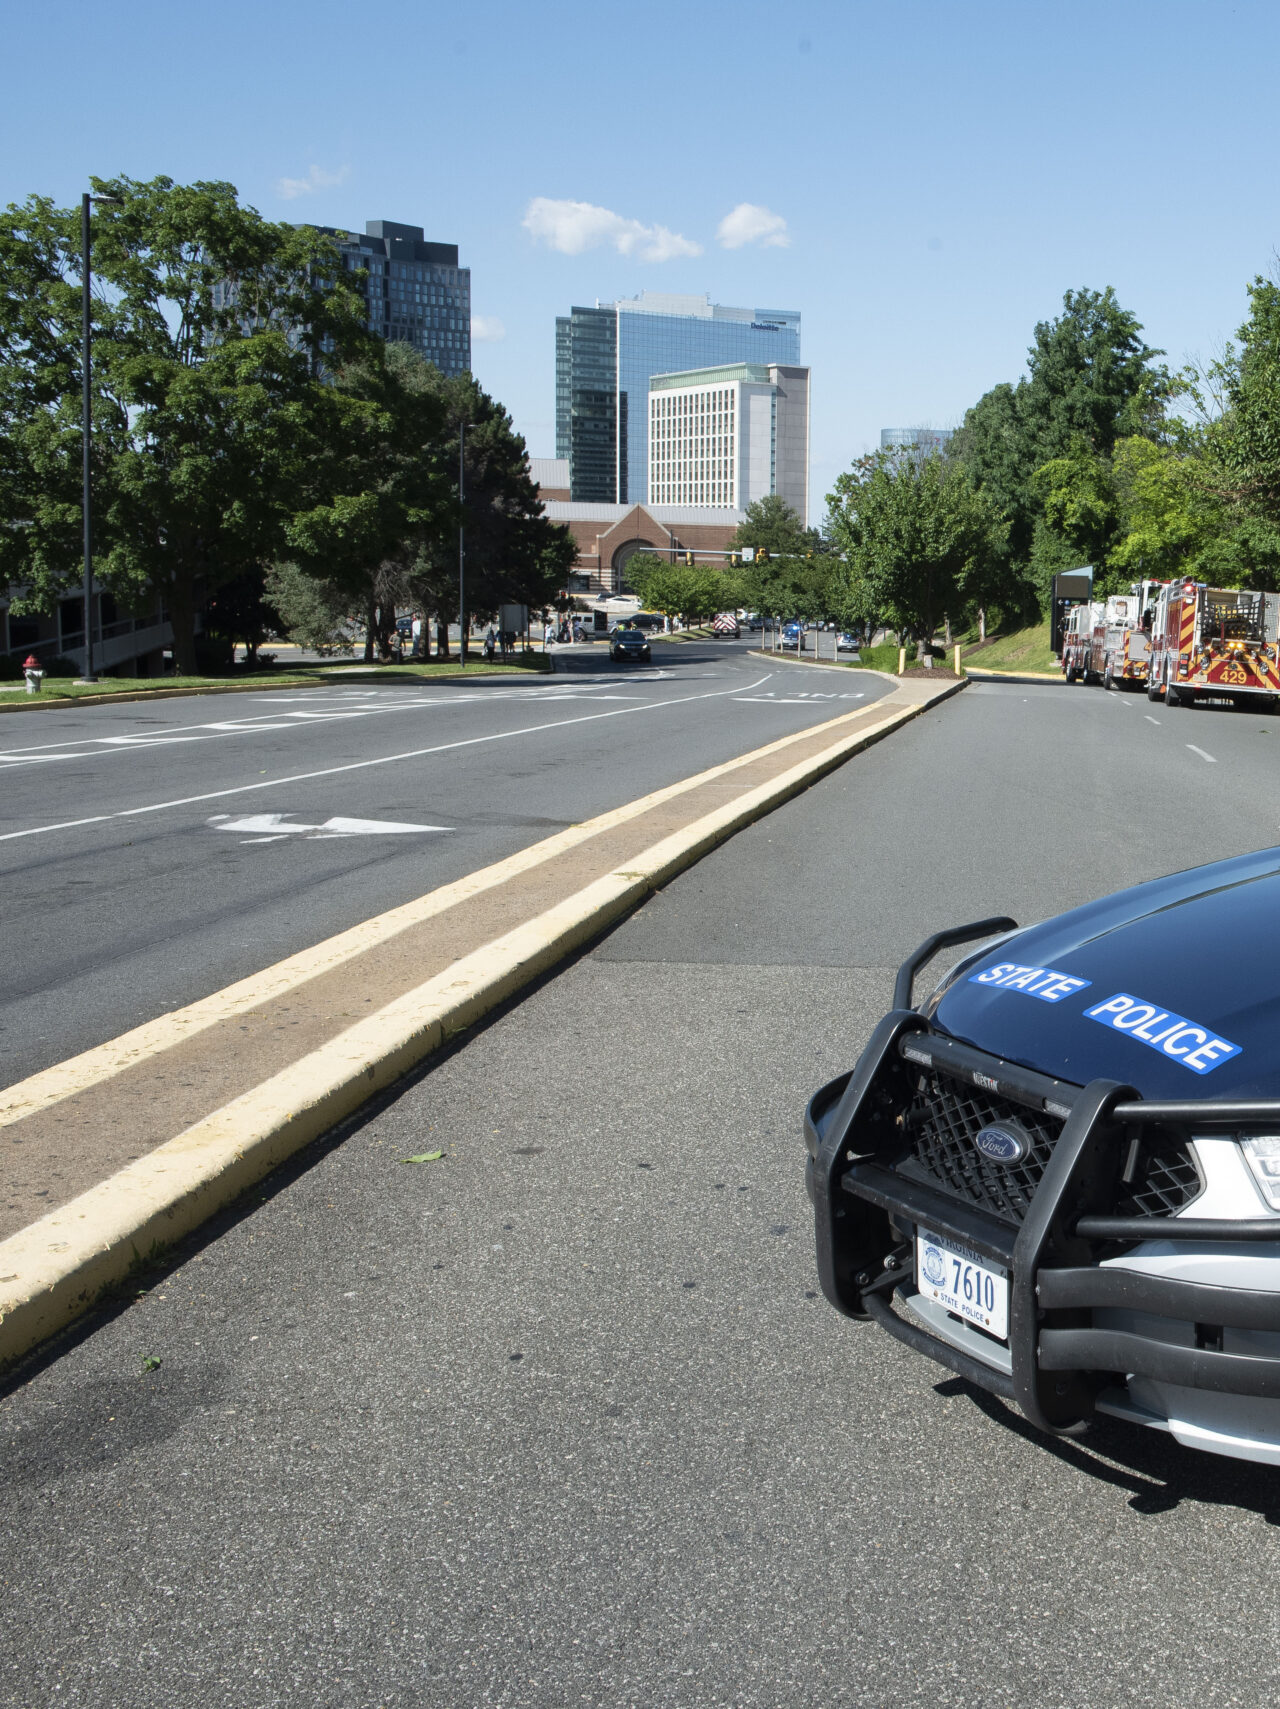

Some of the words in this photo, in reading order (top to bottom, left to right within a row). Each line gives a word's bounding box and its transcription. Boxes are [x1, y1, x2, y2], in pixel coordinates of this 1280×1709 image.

[1219, 670, 1248, 685] 429
[977, 963, 1086, 1000] STATE
[1089, 995, 1235, 1070] POLICE
[982, 1132, 1008, 1155] Ford
[952, 1258, 995, 1312] 7610
[940, 1292, 959, 1308] STATE
[961, 1304, 985, 1322] POLICE
